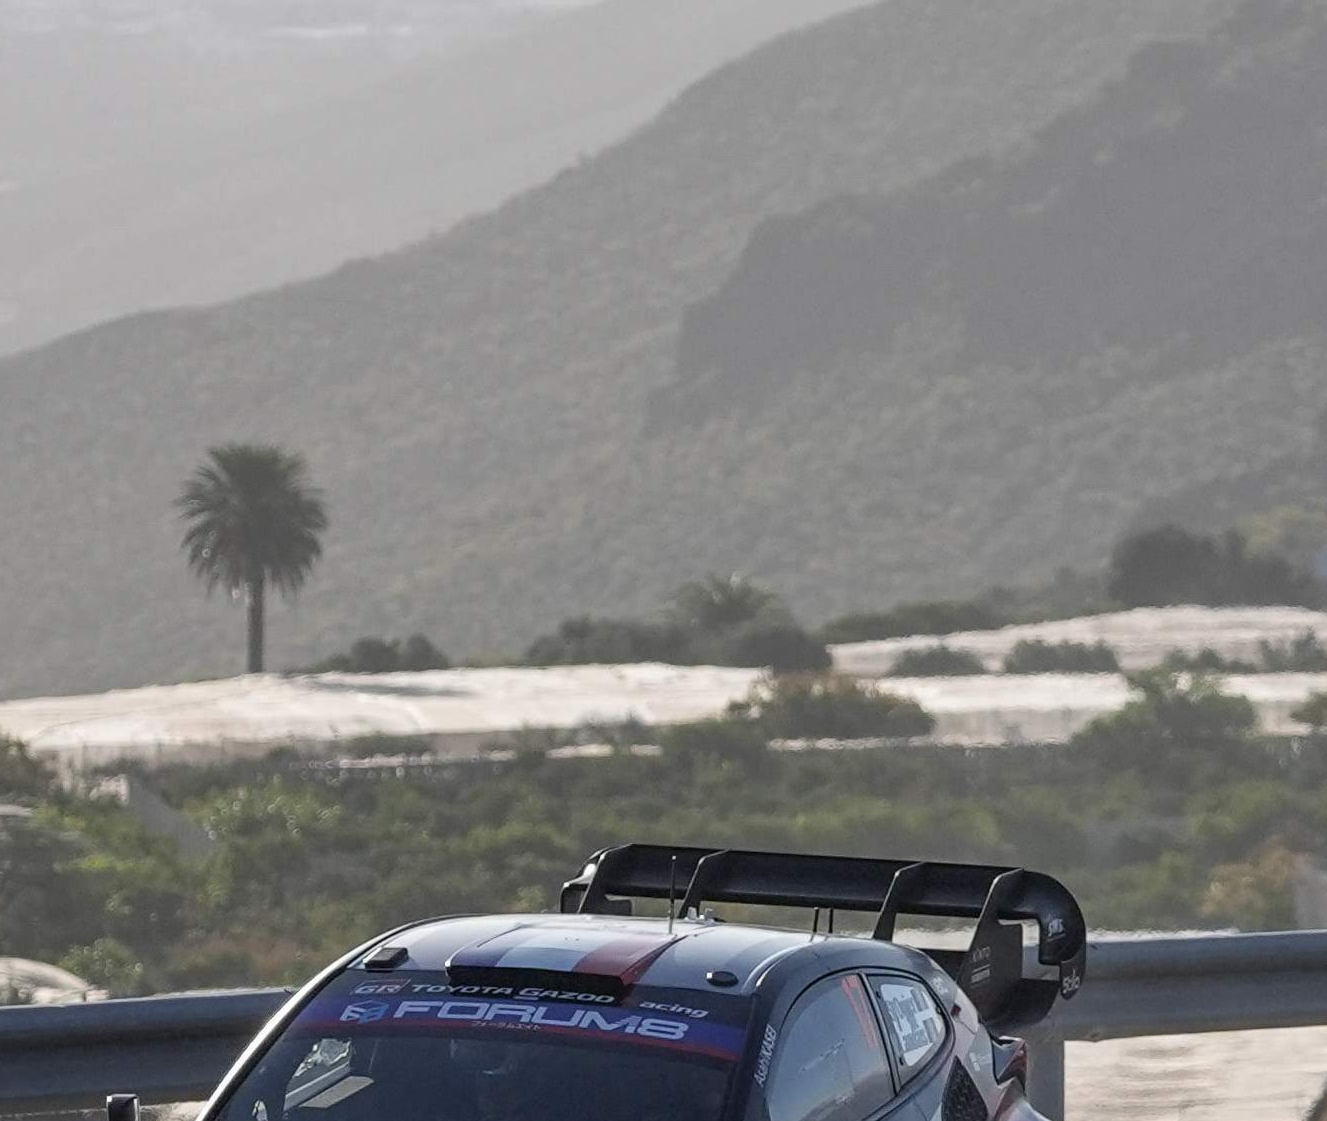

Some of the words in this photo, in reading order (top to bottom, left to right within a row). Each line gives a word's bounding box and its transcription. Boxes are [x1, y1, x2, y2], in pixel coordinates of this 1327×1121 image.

[412, 983, 513, 996] TOYOTA
[518, 986, 616, 1004] GAZOO
[627, 1000, 710, 1019] acing
[393, 1001, 689, 1040] FORUM8
